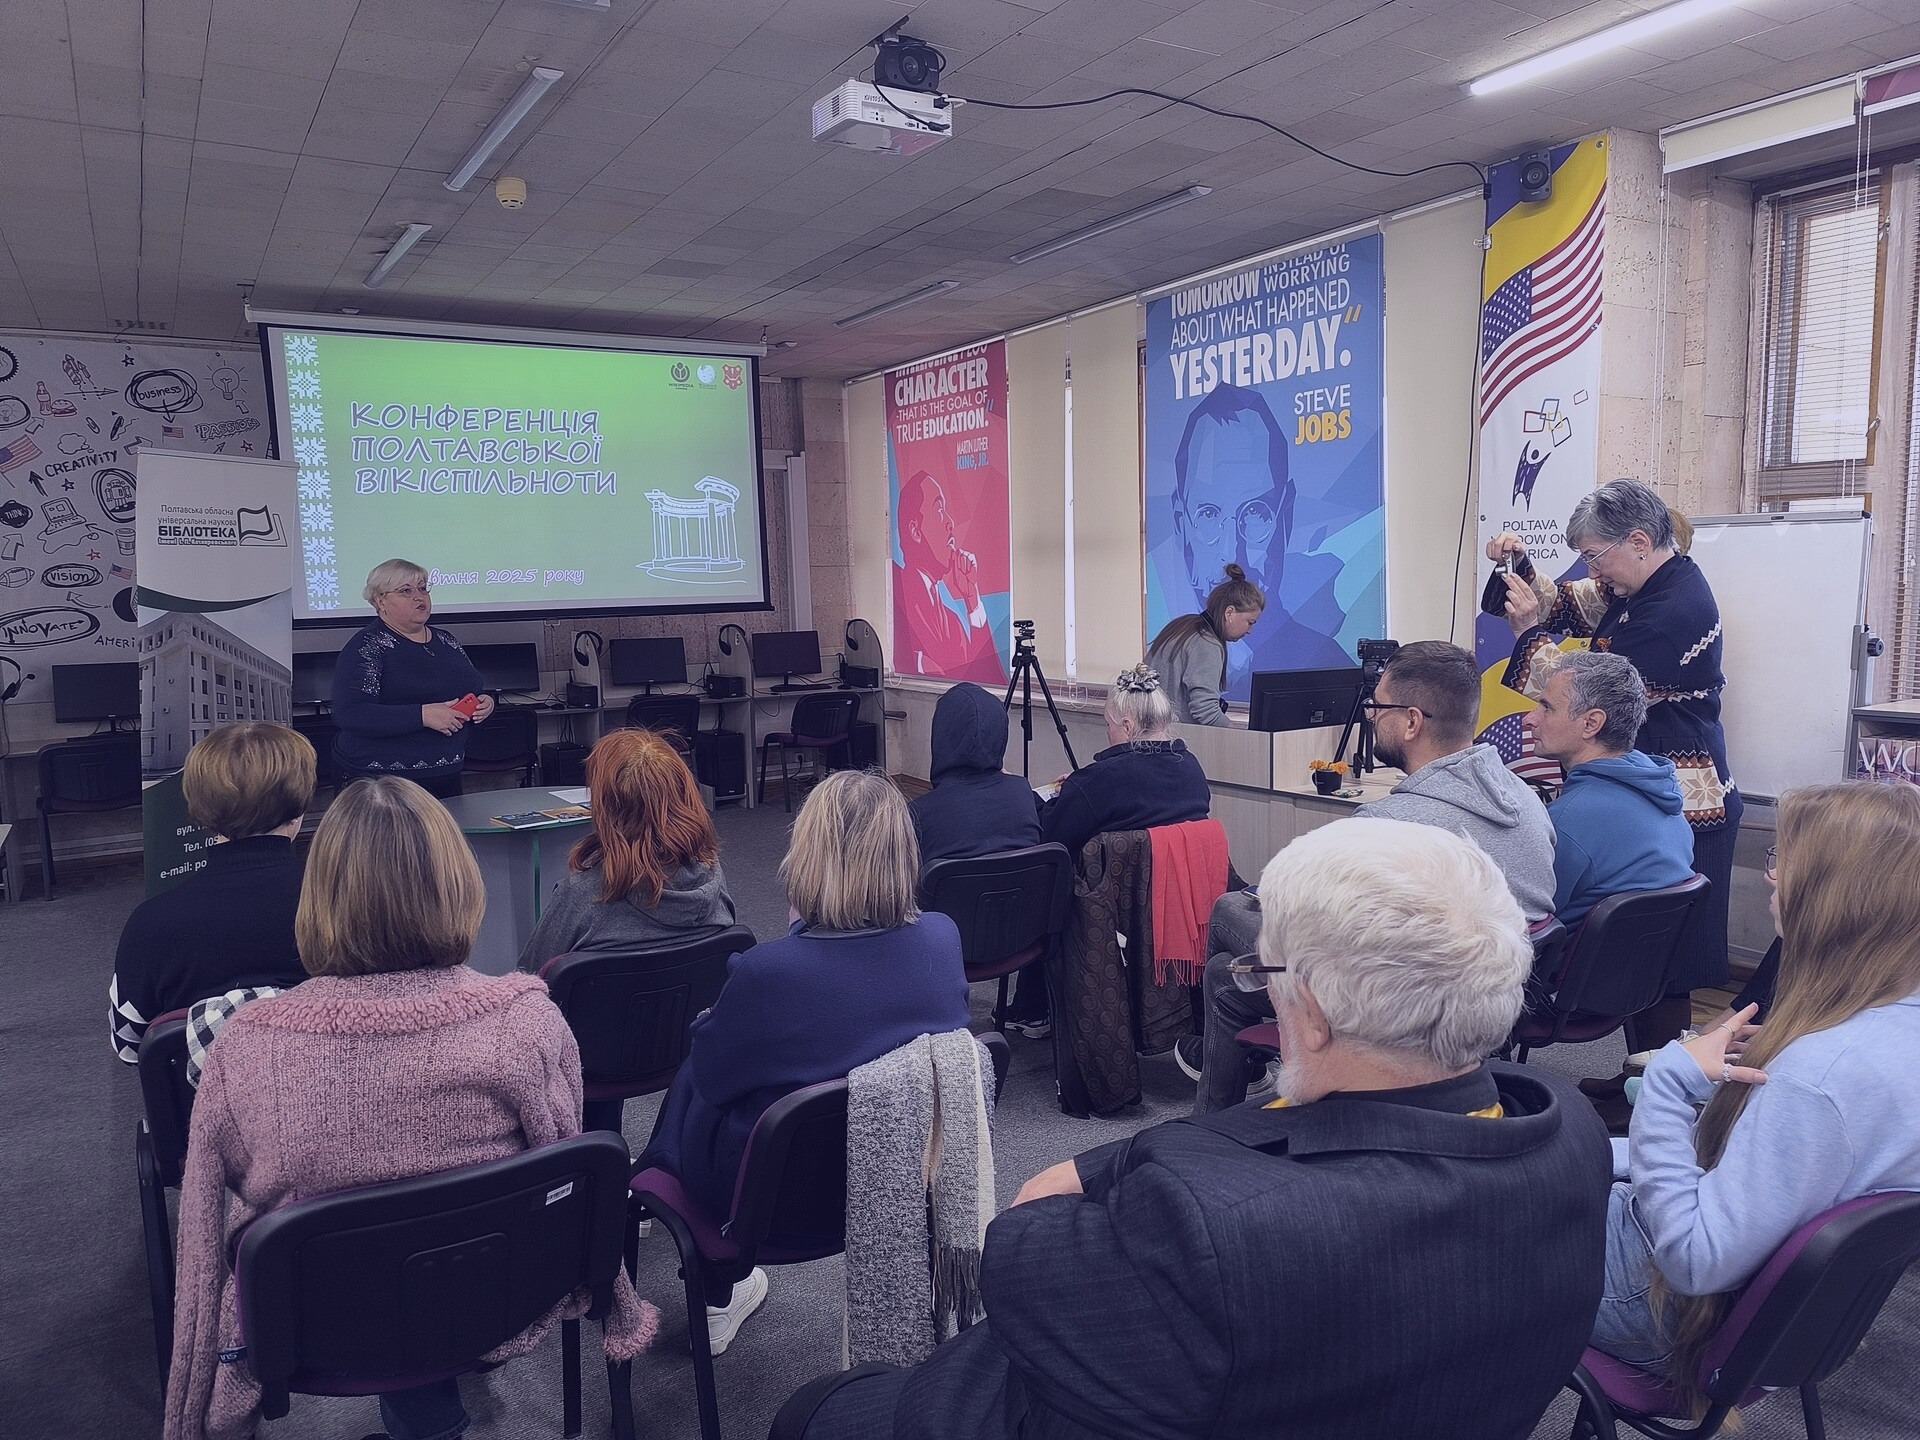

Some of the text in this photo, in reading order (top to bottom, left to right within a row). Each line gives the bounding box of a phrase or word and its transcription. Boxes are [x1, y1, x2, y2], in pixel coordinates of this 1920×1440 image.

[1263, 254, 1350, 293] WORRYING
[1170, 278, 1350, 350] ABOUT WHAT HAPPENED
[895, 357, 989, 407] CHARACTER
[137, 386, 182, 400] business
[920, 404, 928, 417] IS
[929, 400, 944, 415] THE
[947, 393, 972, 411] GOAL
[975, 389, 988, 405] OF
[1294, 384, 1351, 415] STEVE
[351, 401, 599, 439] КОНФЕРЕНЦІЯ
[1295, 409, 1351, 445] JOBS
[896, 421, 922, 444] TRUE
[351, 434, 603, 464] ПОЛТАВСЬКОЇ
[956, 436, 989, 456] MARTIN LUTHER
[355, 467, 617, 495] ВІКІСПІЛЬНОТИ
[161, 504, 234, 516] Полтавська обласна
[157, 516, 237, 528] універсальна наукова
[158, 525, 237, 538] БІБЛІОТЕКА
[1503, 519, 1558, 531] POLTAVA
[1550, 533, 1567, 545] ON
[1526, 548, 1558, 559] RICA
[51, 569, 90, 581] vision
[428, 568, 585, 587] втня 2025 року
[176, 825, 195, 836] вул.
[183, 842, 203, 853] Тел.
[160, 859, 207, 879] e-mail: po
